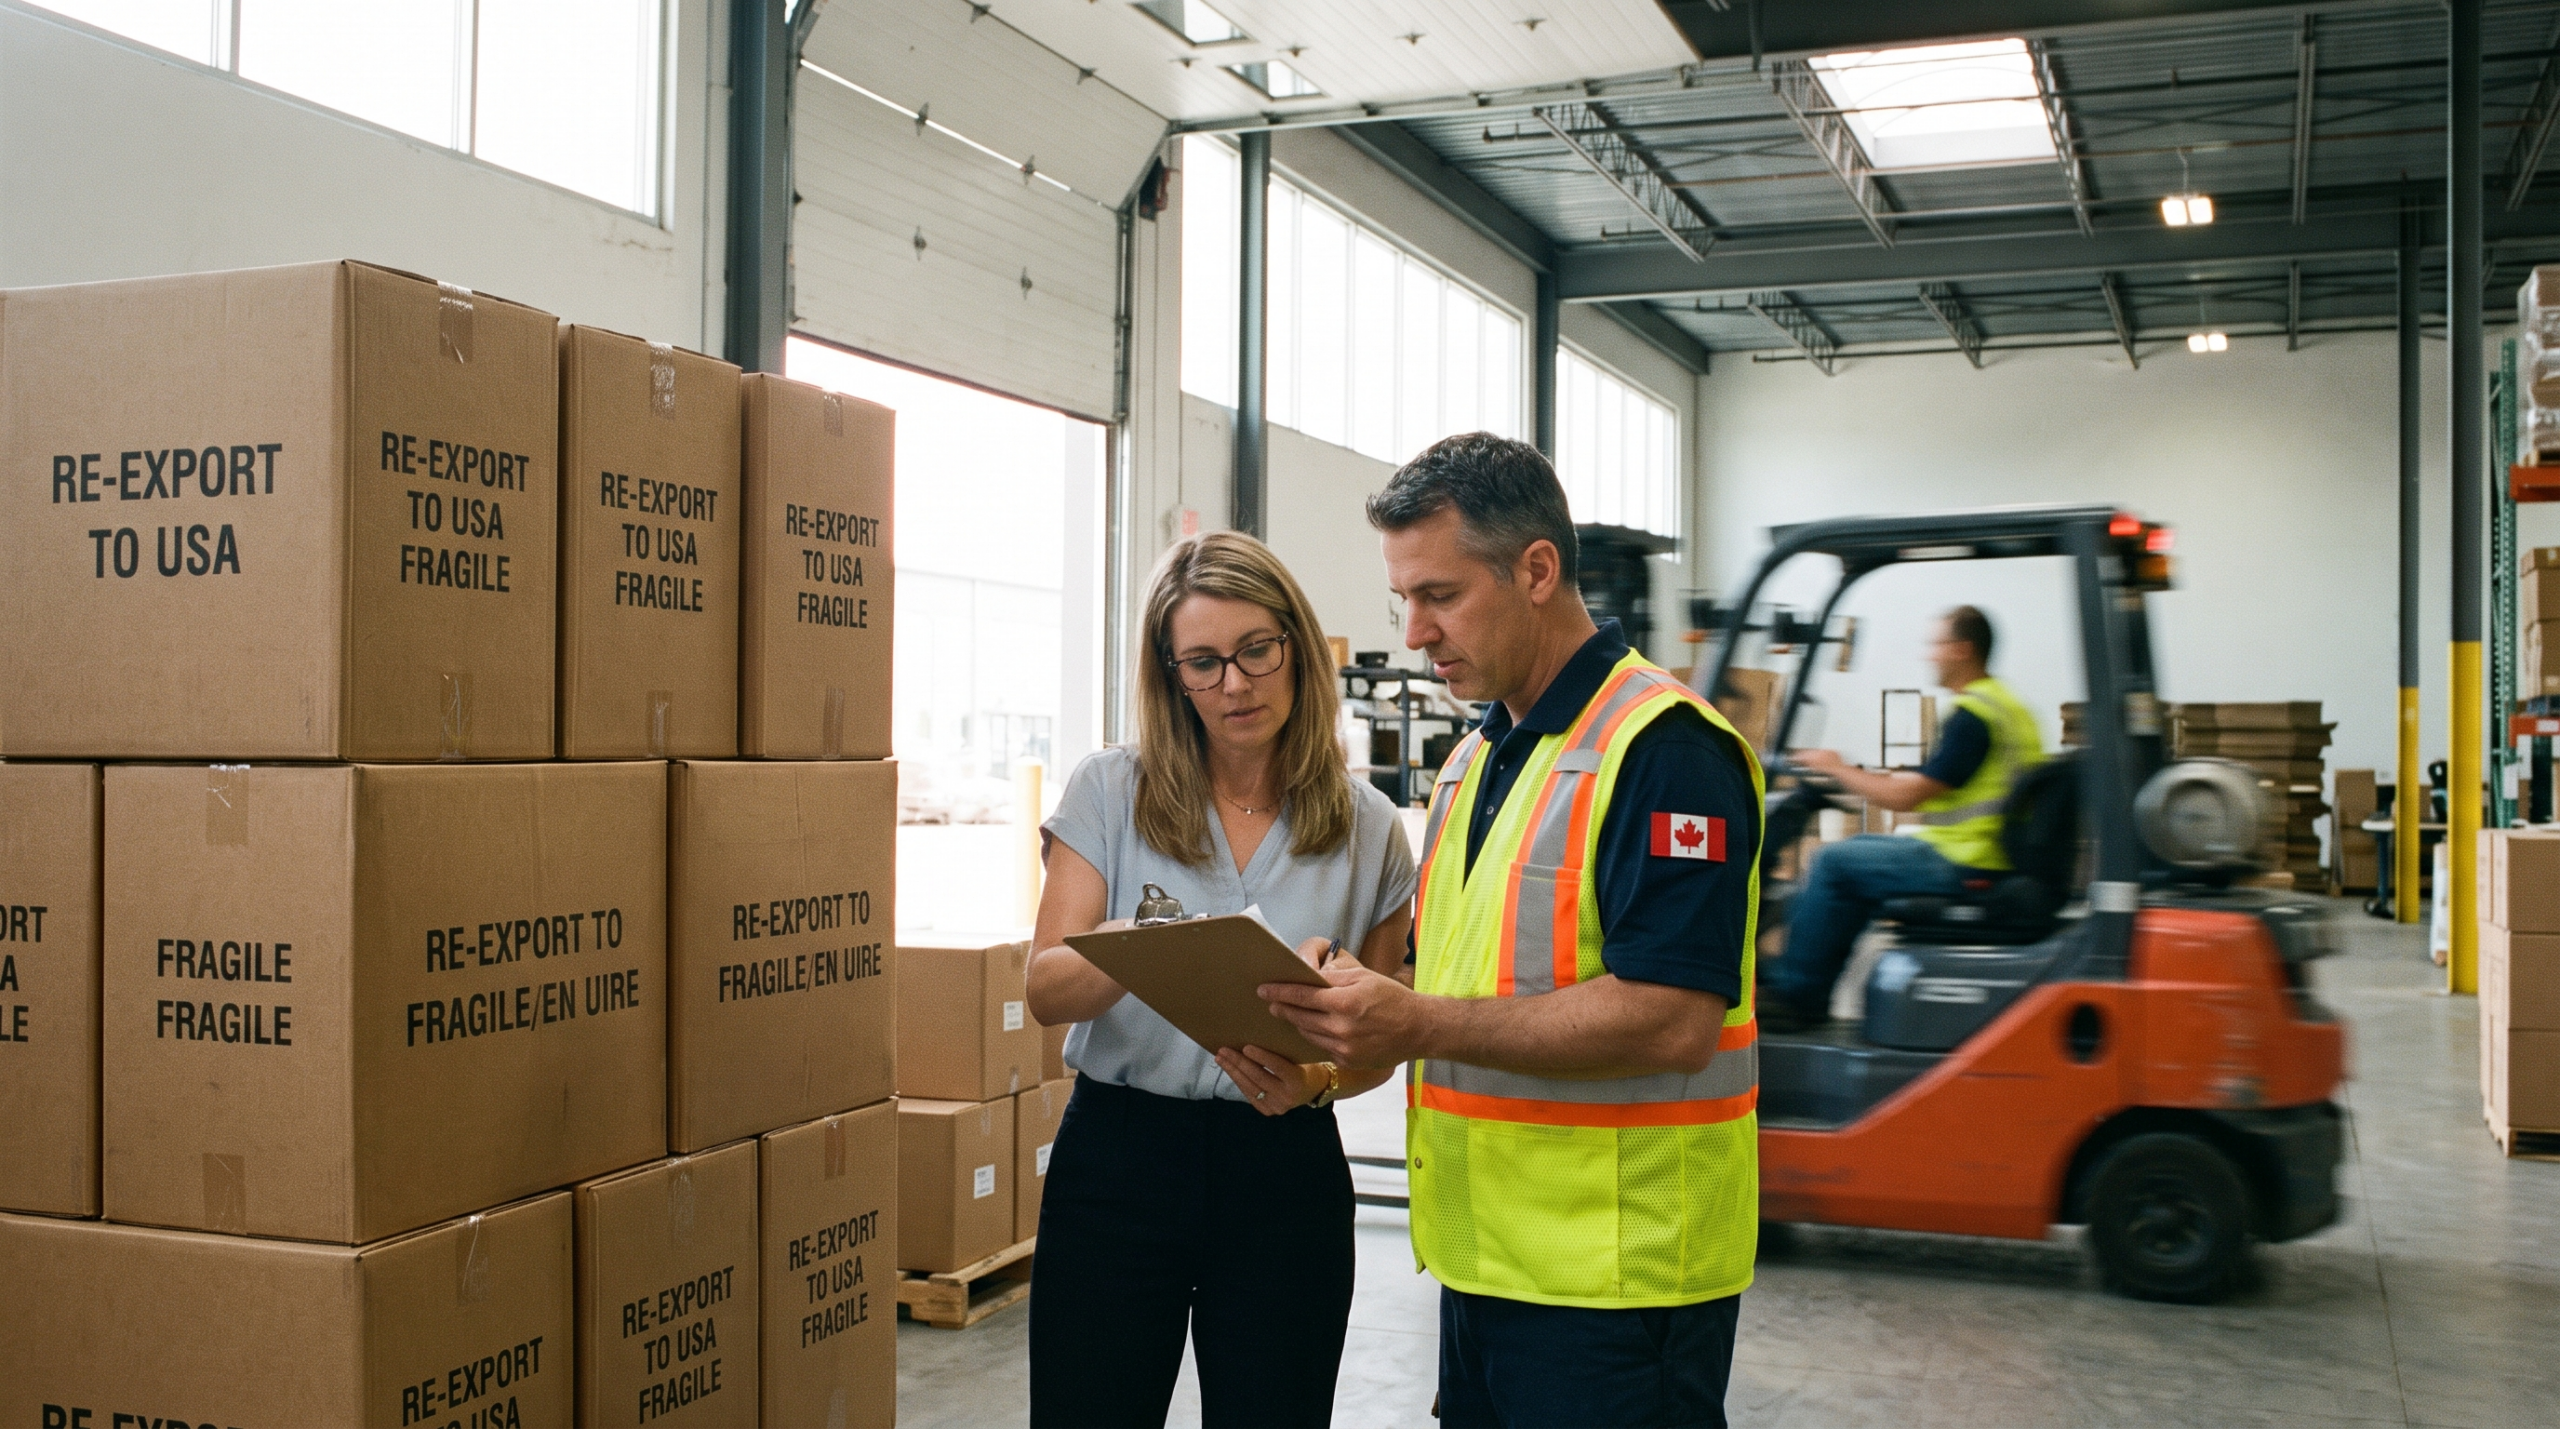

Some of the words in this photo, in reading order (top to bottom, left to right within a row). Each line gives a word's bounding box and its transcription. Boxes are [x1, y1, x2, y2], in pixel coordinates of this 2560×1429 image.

[52, 443, 283, 504] RE-EXPORT
[381, 431, 530, 492] RE-EXPORT
[407, 490, 442, 532] TO
[452, 496, 504, 540] USA
[601, 471, 718, 522] RE-EXPORT
[88, 527, 139, 579] TO
[157, 524, 241, 577] USA
[622, 523, 650, 560] TO
[657, 527, 698, 565] USA
[786, 504, 880, 548] RE-EXPORT
[400, 544, 510, 593] FRAGILE
[615, 570, 703, 613] FRAGILE
[802, 549, 825, 582] TO
[831, 554, 863, 587] USA
[798, 592, 868, 629] FRAGILE
[426, 913, 584, 973] RE-EXPORT
[591, 908, 622, 950] TO
[733, 893, 844, 941] RE-EXPORT
[847, 890, 870, 926] TO
[157, 938, 292, 983] FRAGILE
[719, 950, 838, 1003] FRAGILE/EN
[844, 943, 882, 982] UIRE
[157, 999, 292, 1046] FRAGILE
[407, 979, 576, 1047] FRAGILE/EN
[585, 969, 639, 1016] UIRE
[789, 1209, 879, 1272] RE-EXPORT
[622, 1265, 734, 1339] RE-EXPORT
[806, 1269, 828, 1304] TO
[832, 1255, 864, 1294] USA
[643, 1334, 670, 1375] TO
[677, 1317, 717, 1362] USA
[802, 1292, 868, 1349] FRAGILE
[402, 1335, 544, 1428] RE-EXPORT
[639, 1358, 722, 1425] FRAGILE
